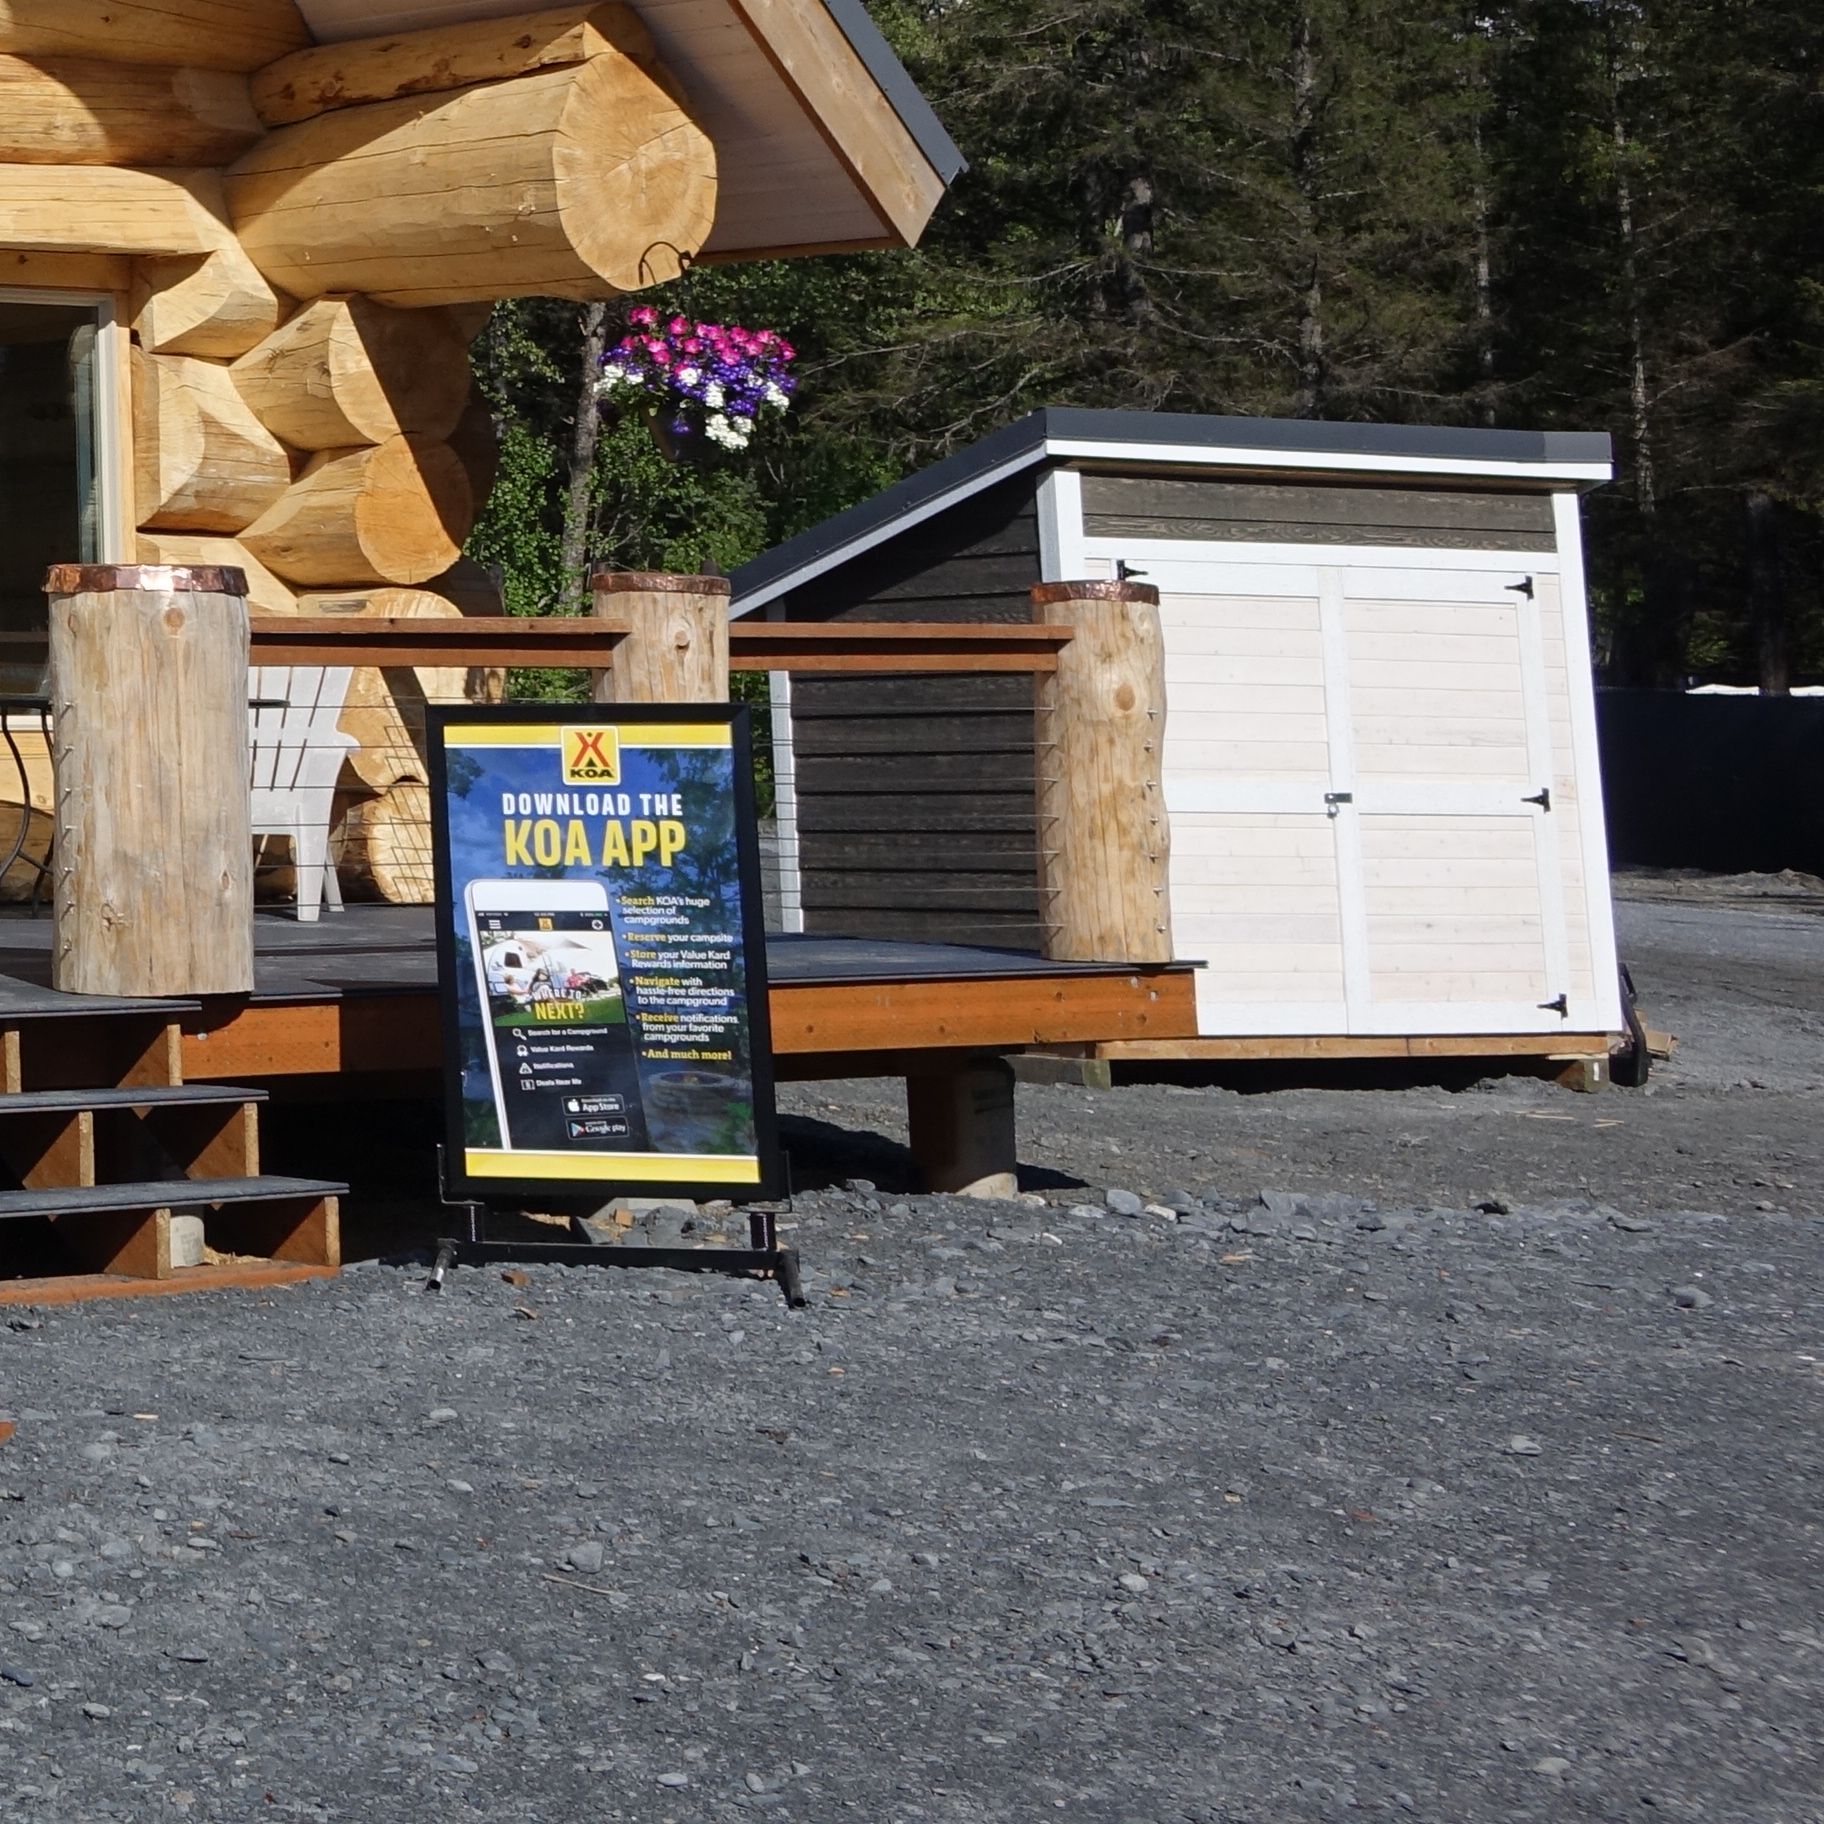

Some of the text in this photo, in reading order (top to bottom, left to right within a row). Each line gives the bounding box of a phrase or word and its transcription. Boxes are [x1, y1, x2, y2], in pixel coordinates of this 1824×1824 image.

[570, 768, 614, 778] KOA
[502, 793, 683, 816] DOWNLOAD THE
[504, 819, 686, 867] KOA APP
[621, 895, 710, 908] Search KOA's huge
[622, 906, 676, 915] selection of
[623, 915, 690, 926] campgrounds
[627, 932, 733, 944] Reserve your campsite
[630, 949, 731, 960] Store your Value Kard
[631, 959, 728, 969] Rewards information
[635, 976, 703, 987] Navigate with
[636, 986, 734, 996] hassle-free directions
[637, 996, 728, 1007] to the campground
[534, 1002, 585, 1020] NEXT?
[640, 1013, 738, 1024] Receive notifications
[642, 1022, 725, 1033] from your favorite
[644, 1033, 710, 1043] campgrounds
[647, 1049, 732, 1061] And much more!
[582, 1102, 620, 1113] App Store
